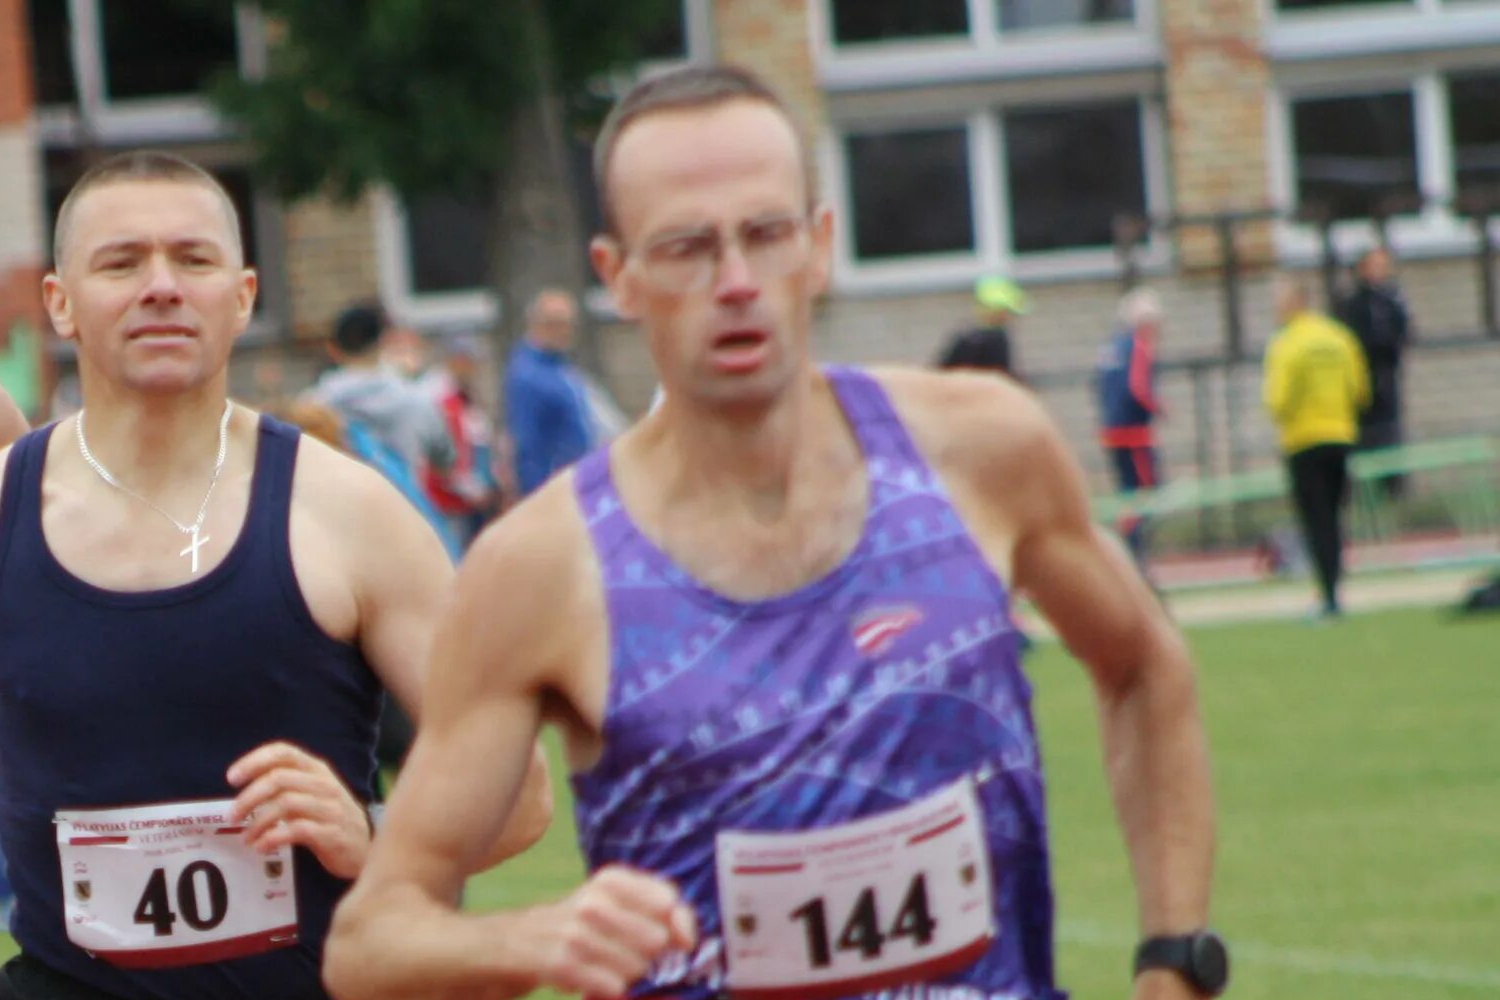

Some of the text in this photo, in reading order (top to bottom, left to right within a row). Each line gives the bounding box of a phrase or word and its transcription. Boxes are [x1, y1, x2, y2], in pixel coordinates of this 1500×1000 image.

[82, 819, 126, 831] LATVIJAS
[133, 860, 228, 936] 40
[789, 870, 937, 970] 144
